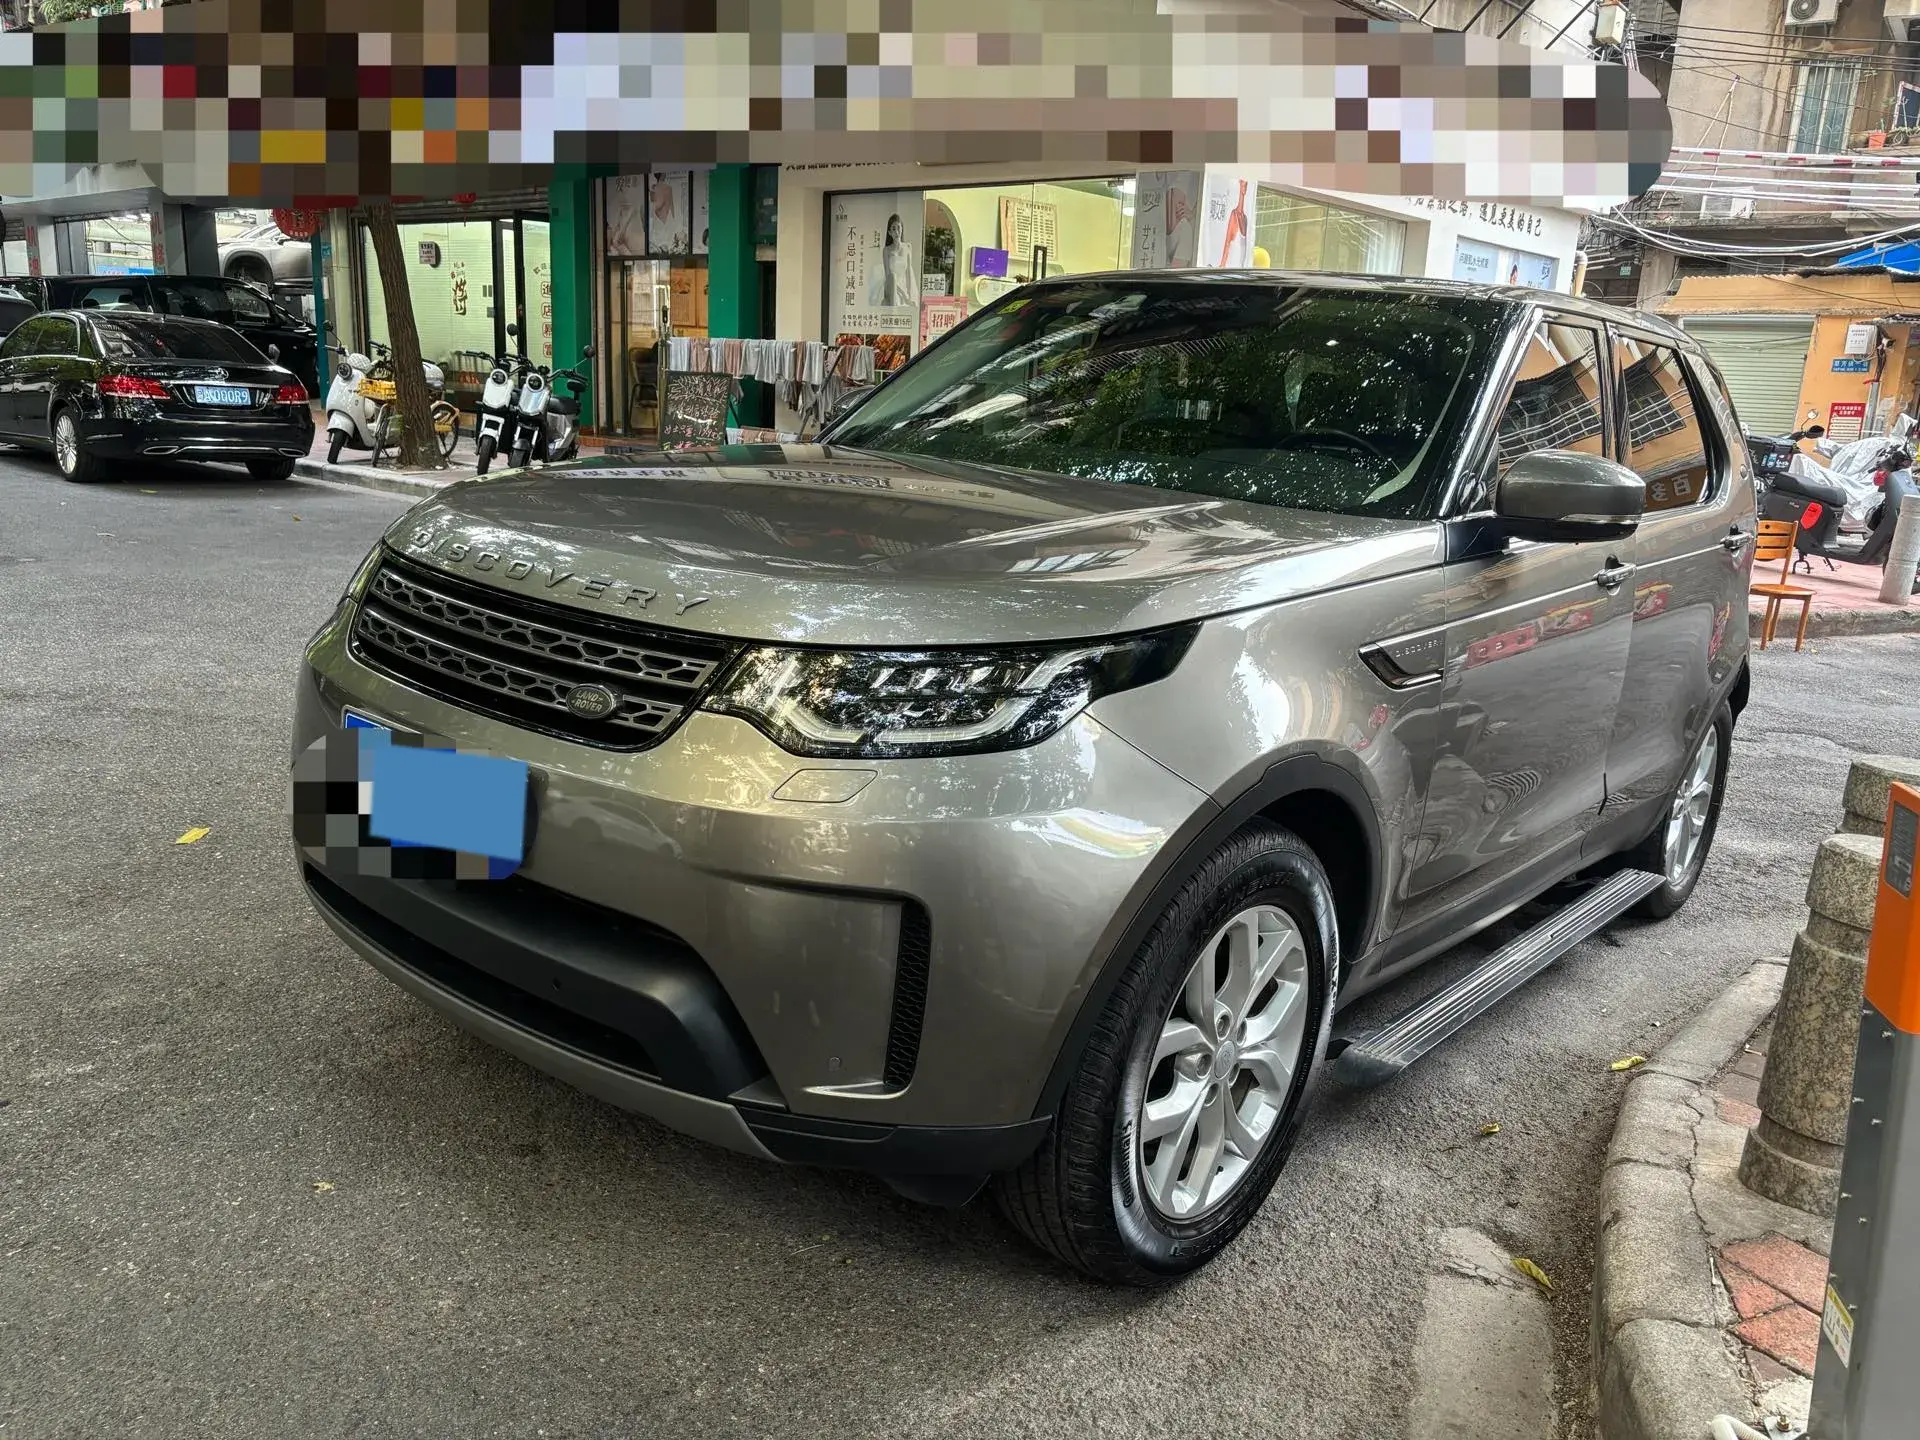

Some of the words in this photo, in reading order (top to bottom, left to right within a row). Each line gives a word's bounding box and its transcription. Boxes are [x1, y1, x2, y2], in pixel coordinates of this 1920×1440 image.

[844, 226, 857, 306] 不忌口减肥
[931, 313, 956, 329] 招聘
[411, 531, 711, 616] DISCOVERY
